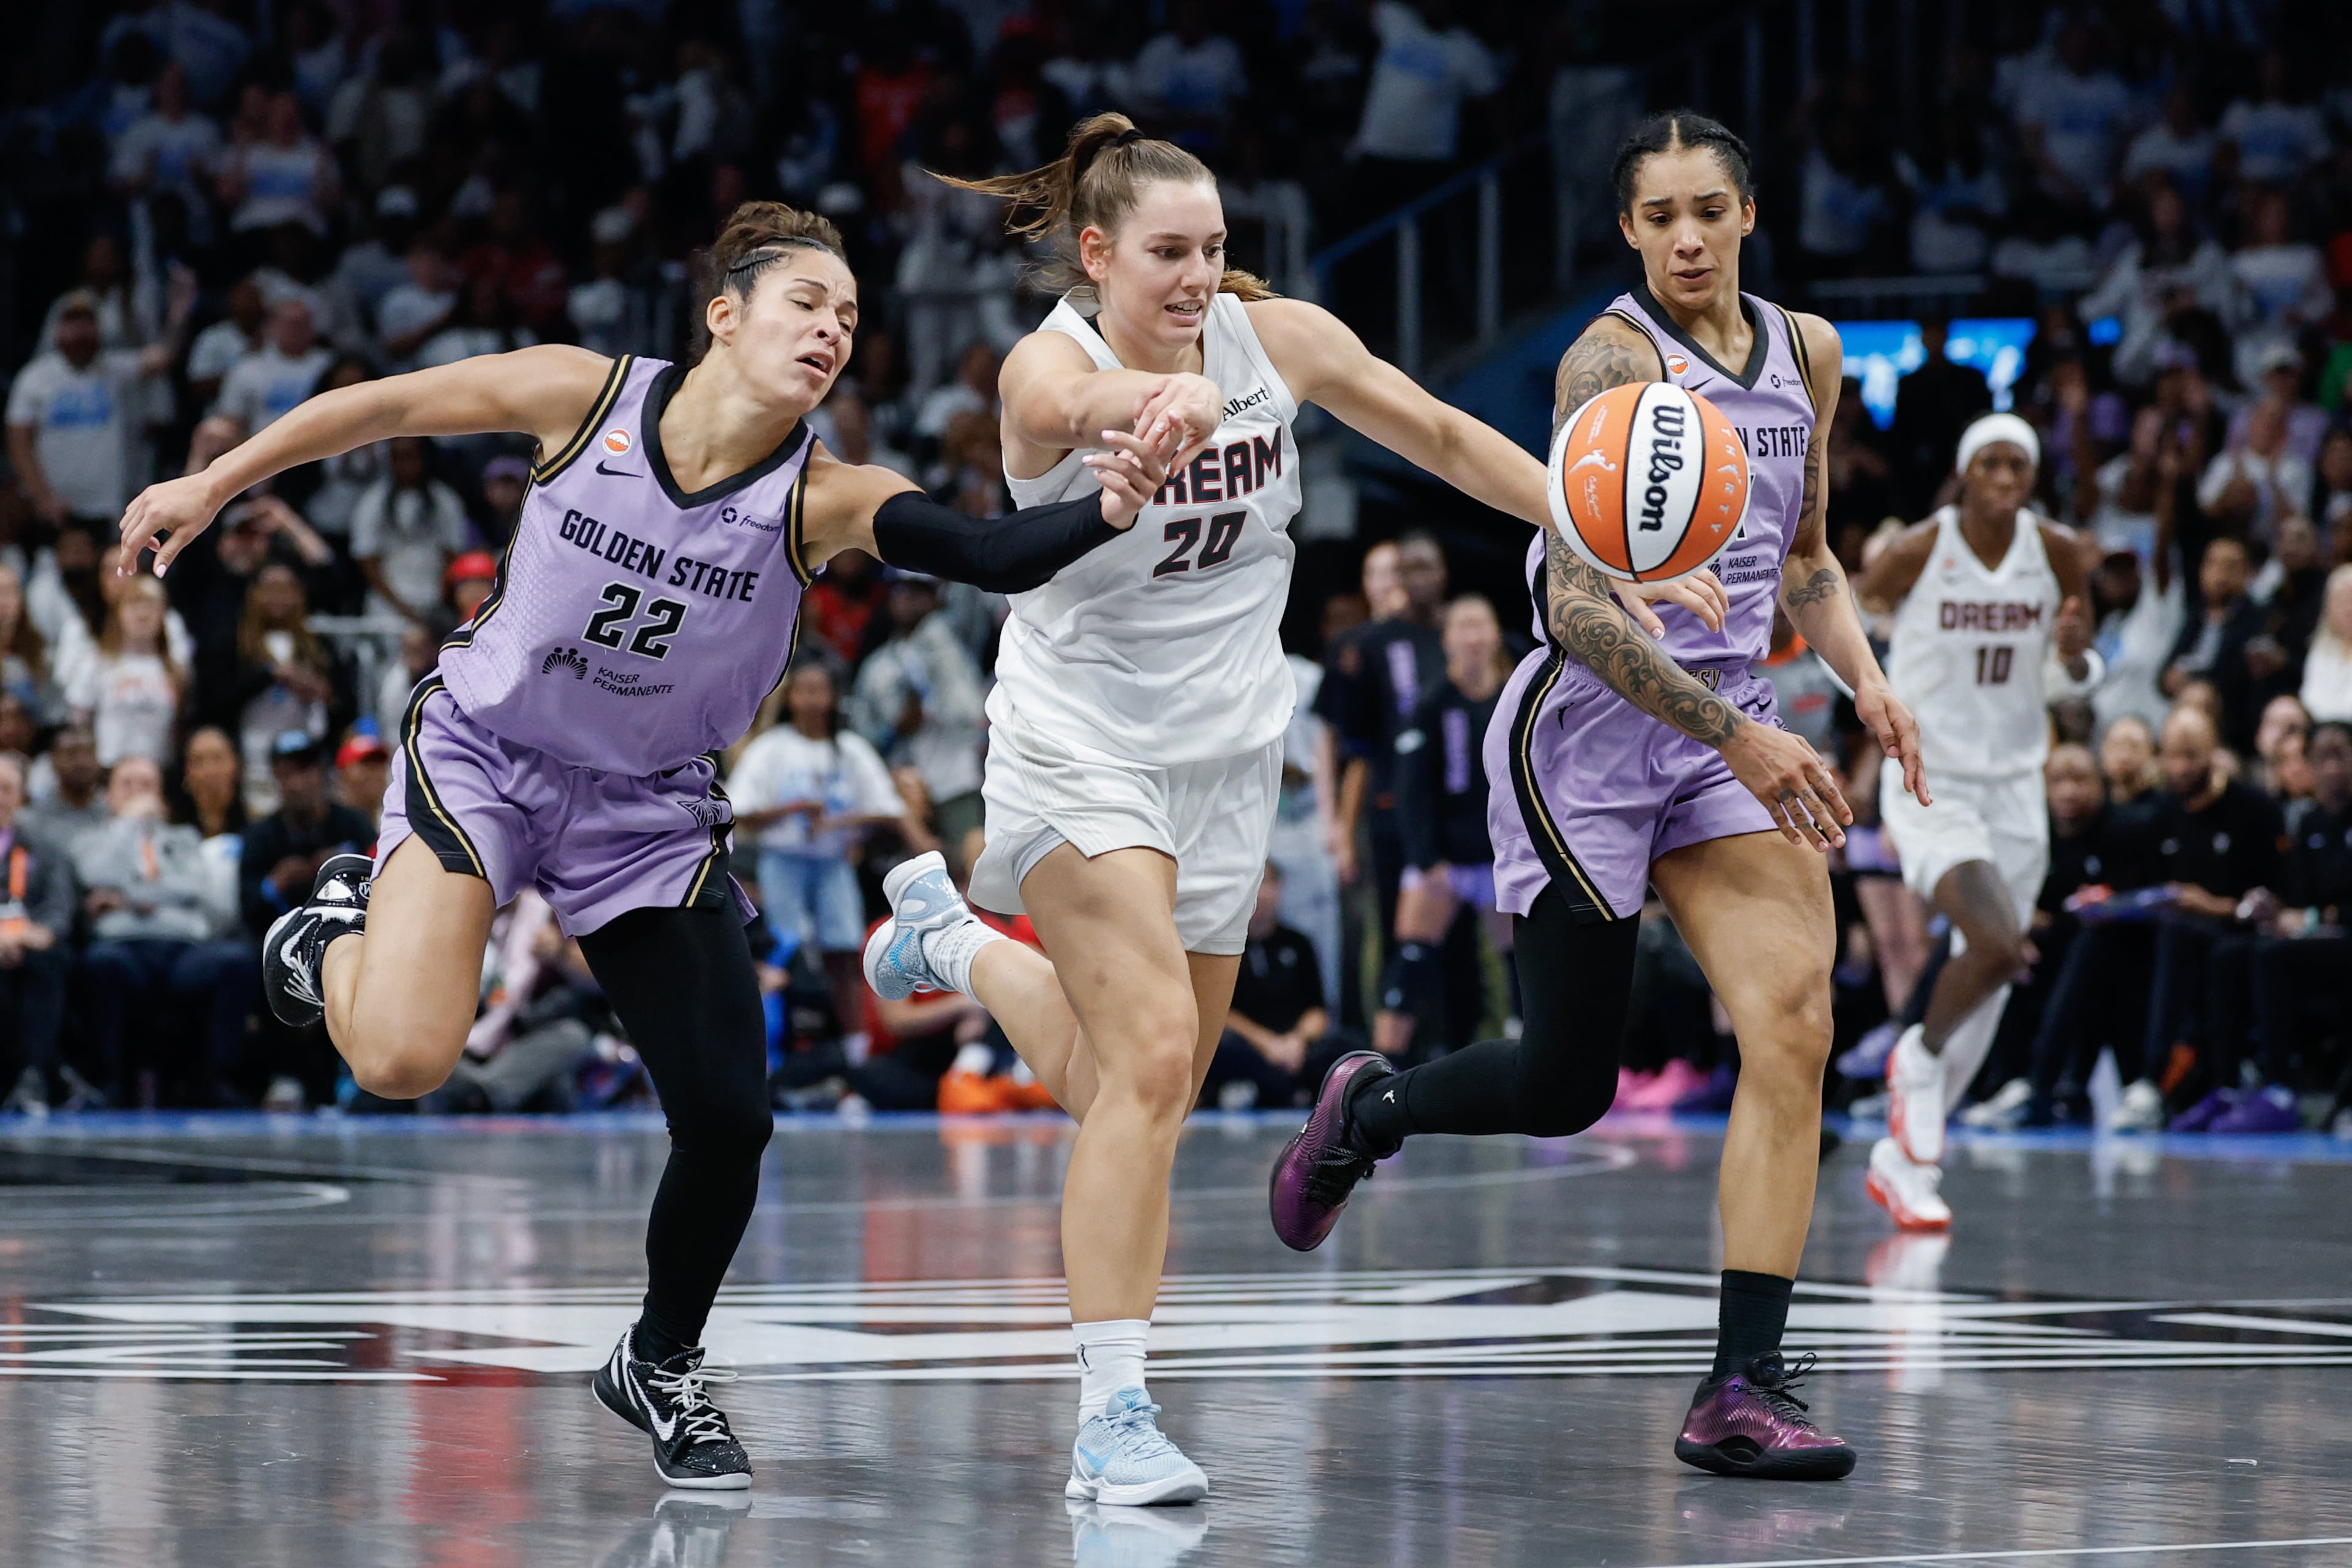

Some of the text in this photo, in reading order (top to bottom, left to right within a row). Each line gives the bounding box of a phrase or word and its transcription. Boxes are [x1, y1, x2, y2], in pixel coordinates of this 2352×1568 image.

[1222, 386, 1270, 421] Albert
[1756, 426, 1806, 457] STATE
[1152, 425, 1283, 505] REAM
[1638, 405, 1685, 532] Wilson
[559, 509, 760, 602] GOLDEN STATE
[1152, 510, 1247, 578] 20
[1726, 568, 1779, 584] PERMANENTE
[1728, 556, 1757, 568] KAISER
[581, 580, 690, 661] 22
[1940, 600, 2043, 631] DREAM
[598, 666, 640, 684] KAISER
[1977, 644, 2014, 687] 10
[593, 677, 675, 696] PERMANENTE
